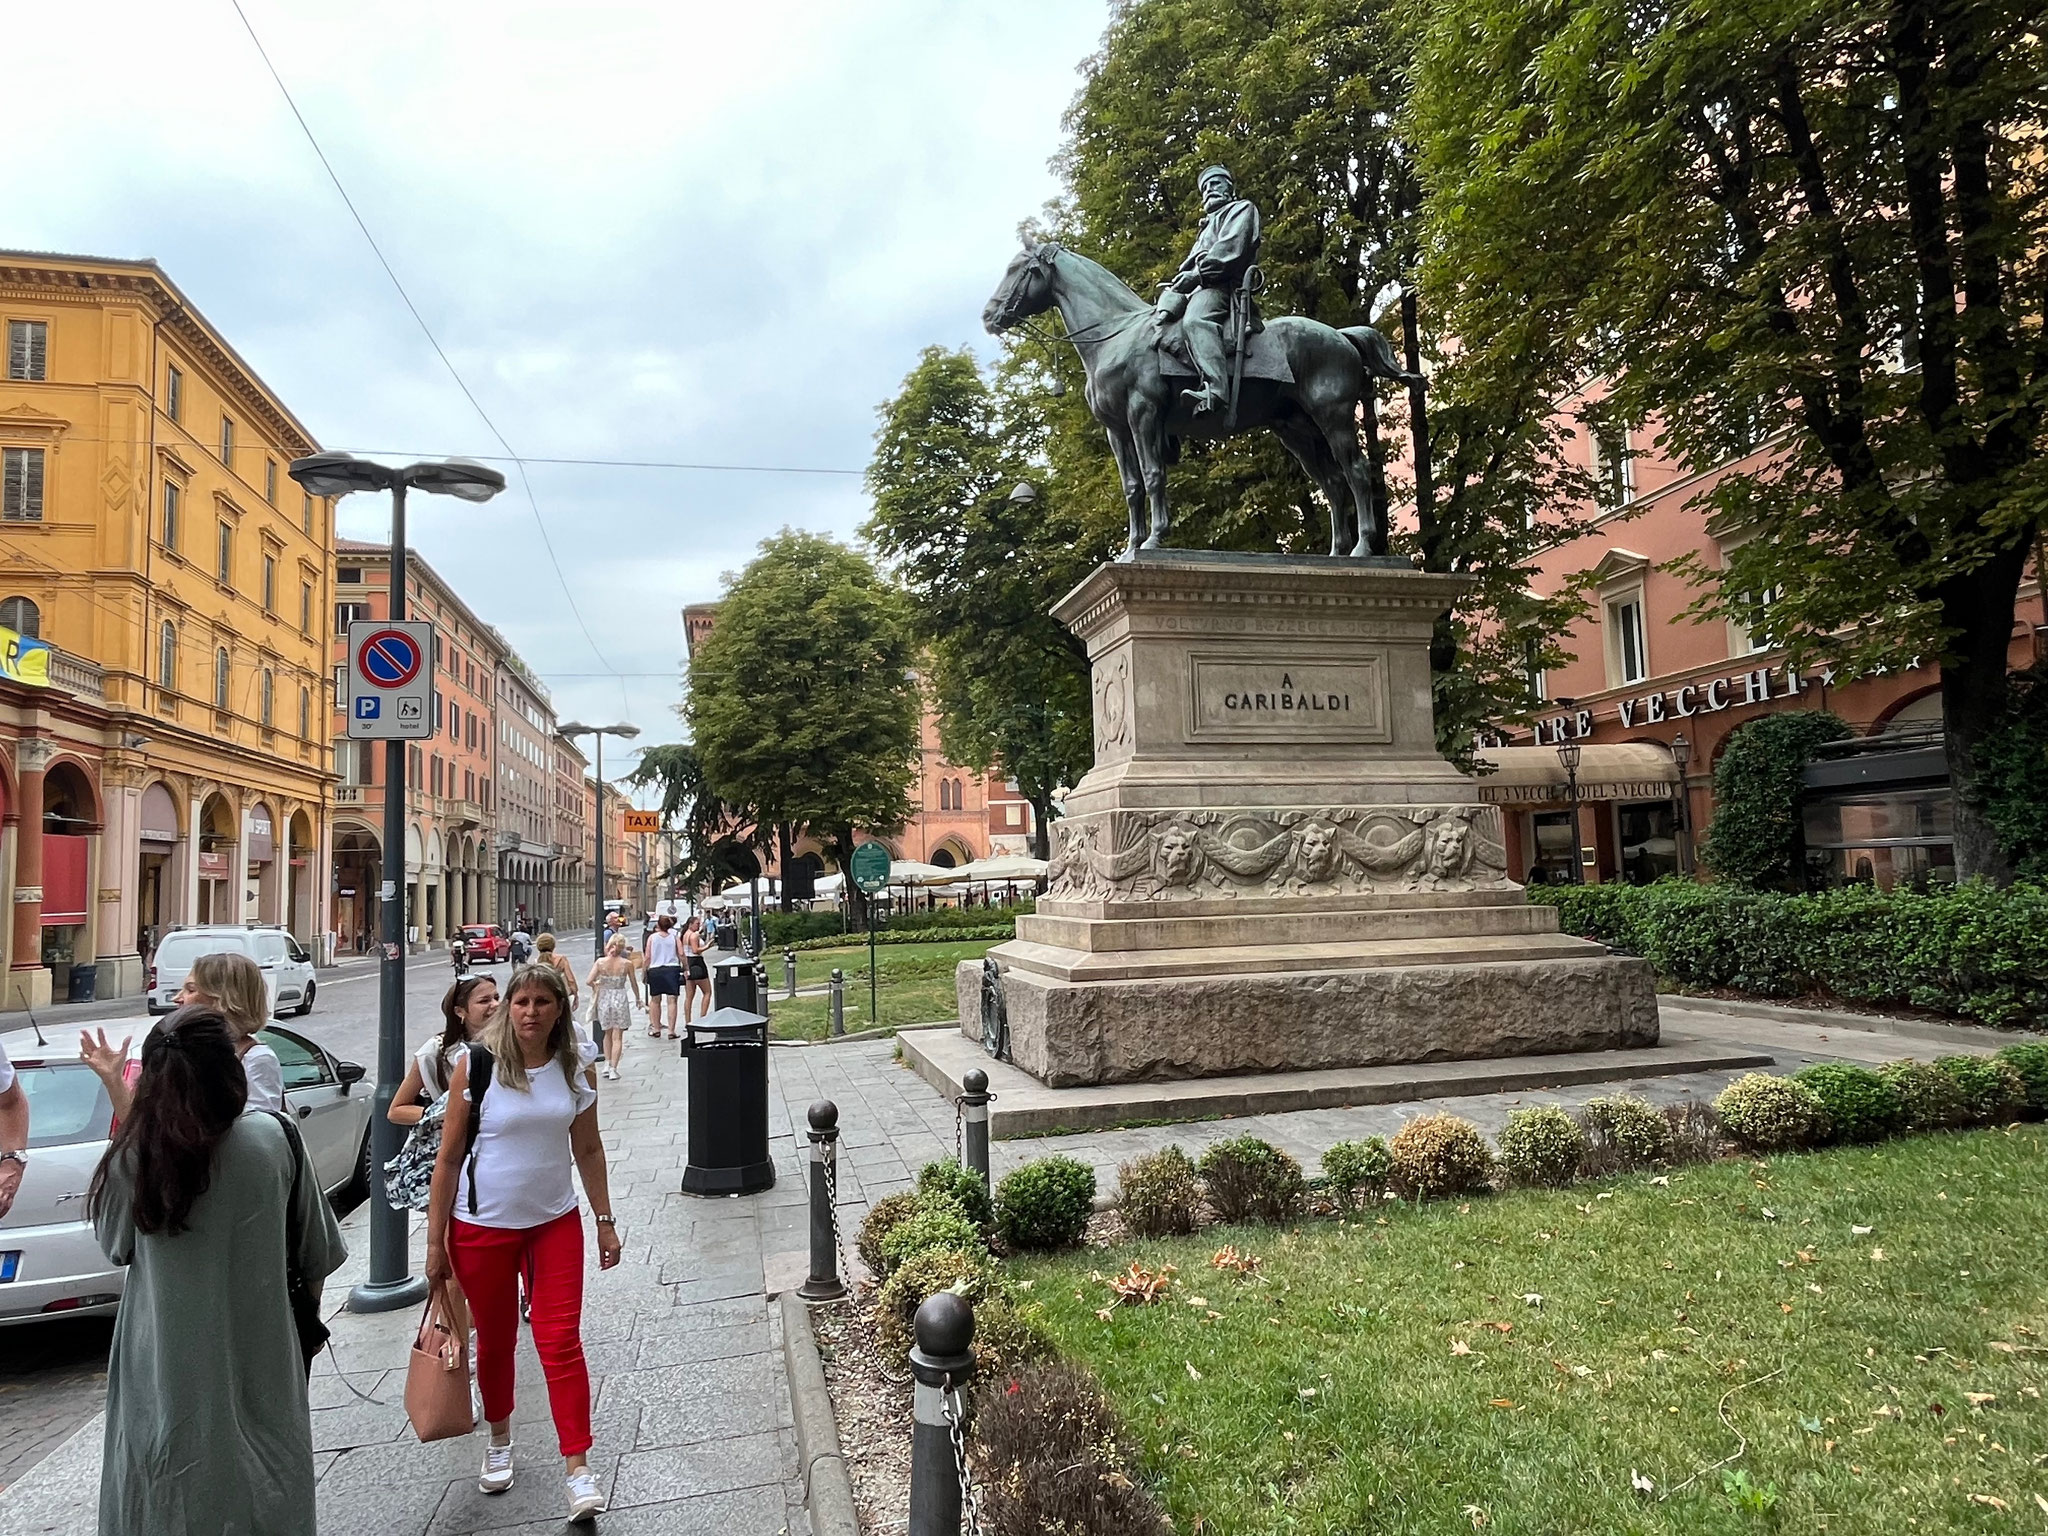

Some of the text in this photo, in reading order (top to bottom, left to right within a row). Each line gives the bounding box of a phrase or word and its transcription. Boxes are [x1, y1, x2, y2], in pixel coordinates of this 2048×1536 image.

[1281, 673, 1293, 689] A
[361, 699, 375, 717] P
[1224, 693, 1350, 711] GARIBALDI
[1513, 785, 1557, 801] VECCH
[1611, 783, 1618, 798] 3
[1622, 781, 1667, 798] VECCHI
[627, 816, 657, 827] TAXI
